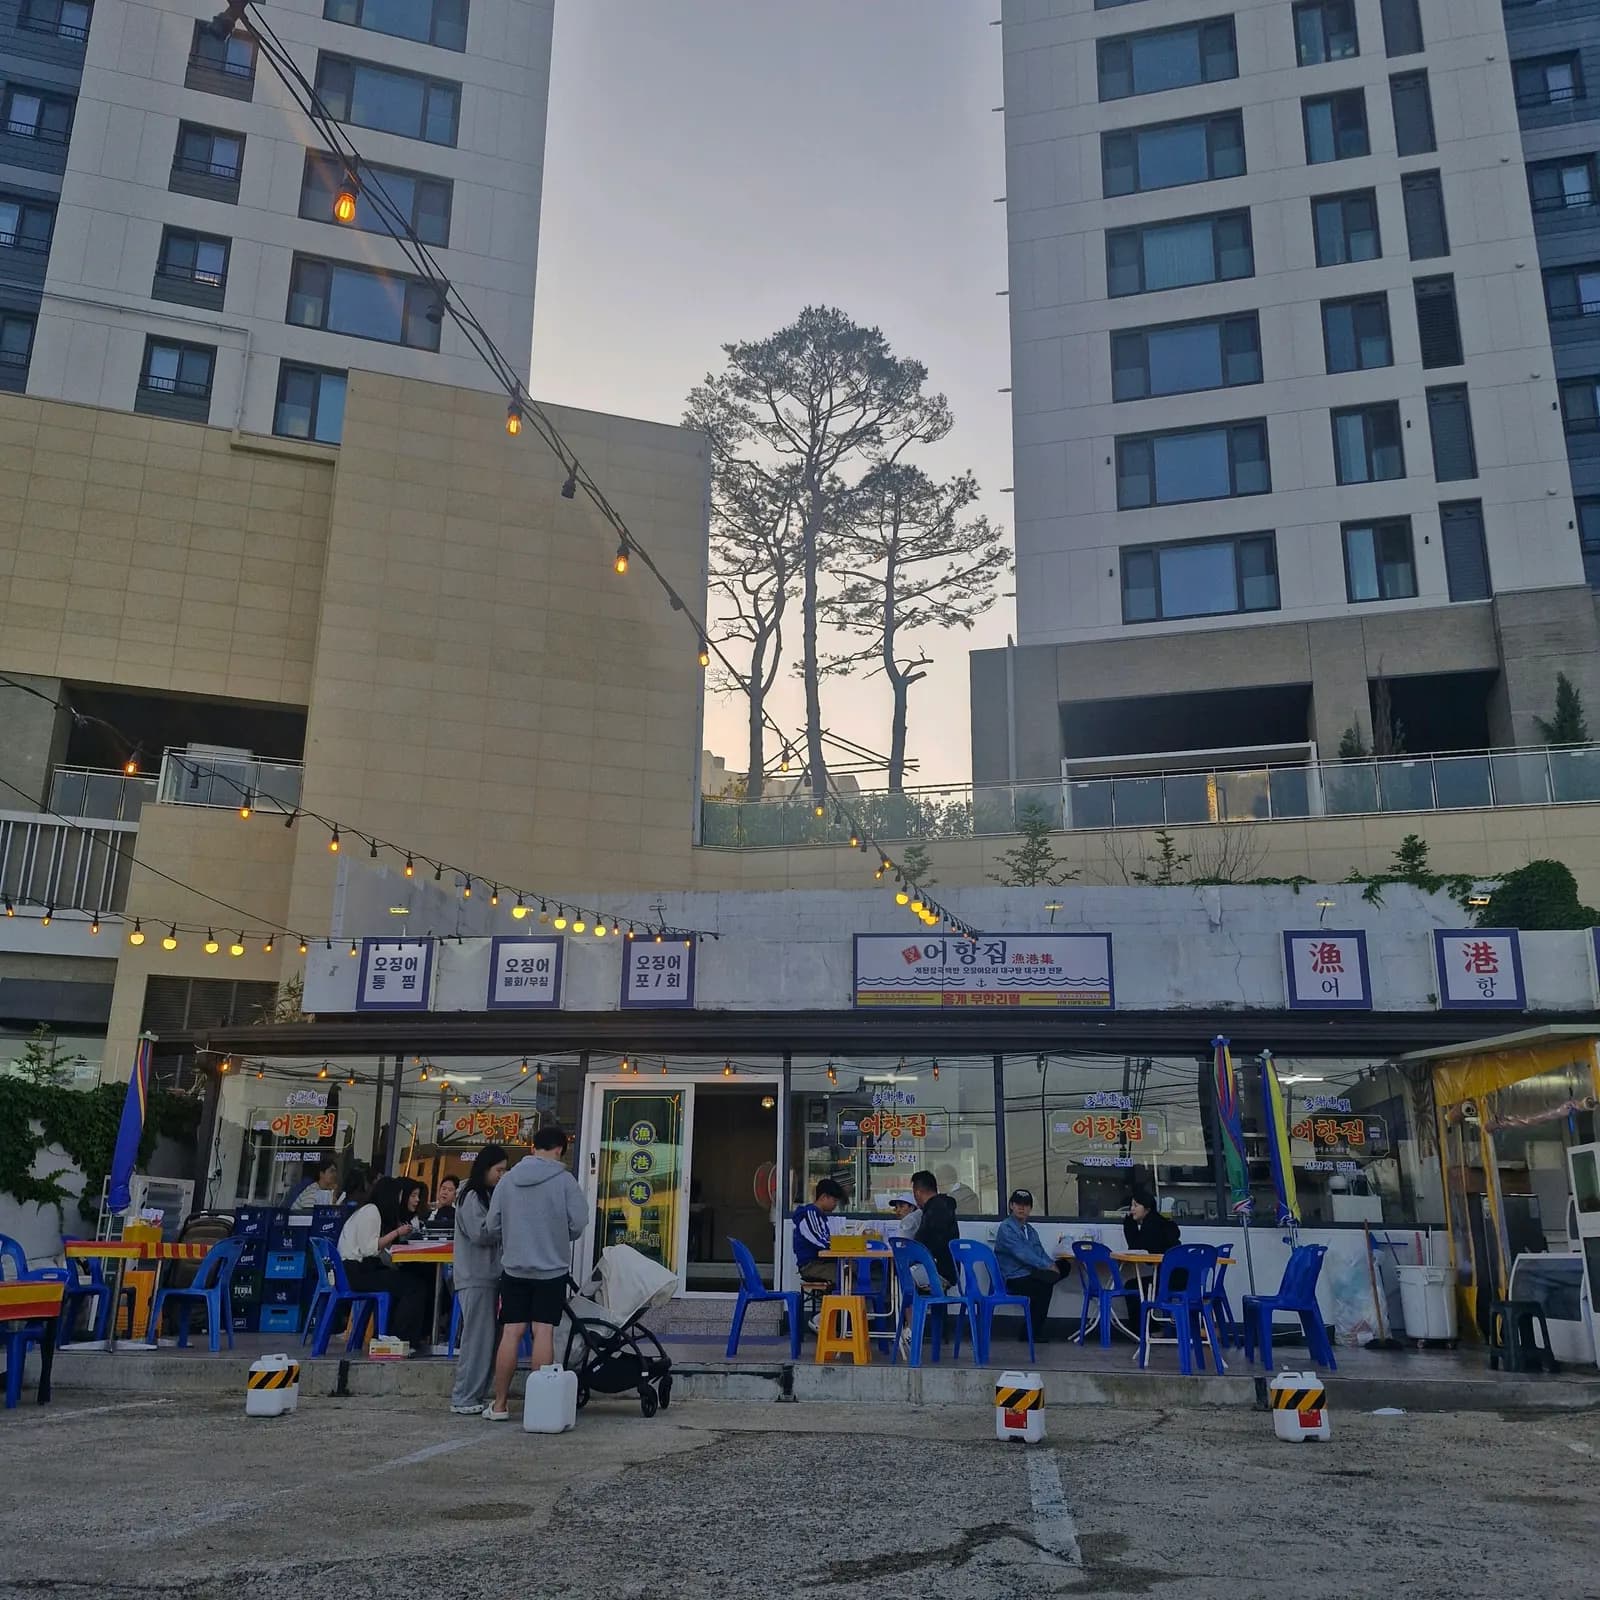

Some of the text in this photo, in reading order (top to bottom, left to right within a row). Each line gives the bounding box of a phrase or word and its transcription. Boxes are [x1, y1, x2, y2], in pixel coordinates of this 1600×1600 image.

[373, 956, 419, 972] 오징어
[635, 955, 681, 971] 오징어
[923, 940, 1007, 965] 어항집
[1308, 942, 1345, 974] 漁
[1461, 941, 1499, 974] 港
[504, 958, 550, 974] 오징어
[371, 975, 416, 990] 통 찜
[503, 976, 549, 988] 물회/무침
[1321, 977, 1339, 998] 어
[1476, 977, 1497, 998] 항
[271, 1113, 336, 1137] 어항집
[455, 1112, 520, 1136] 어항집
[859, 1111, 927, 1138] 어항집
[1072, 1115, 1144, 1142] 어항집
[1291, 1118, 1366, 1145] 어항집
